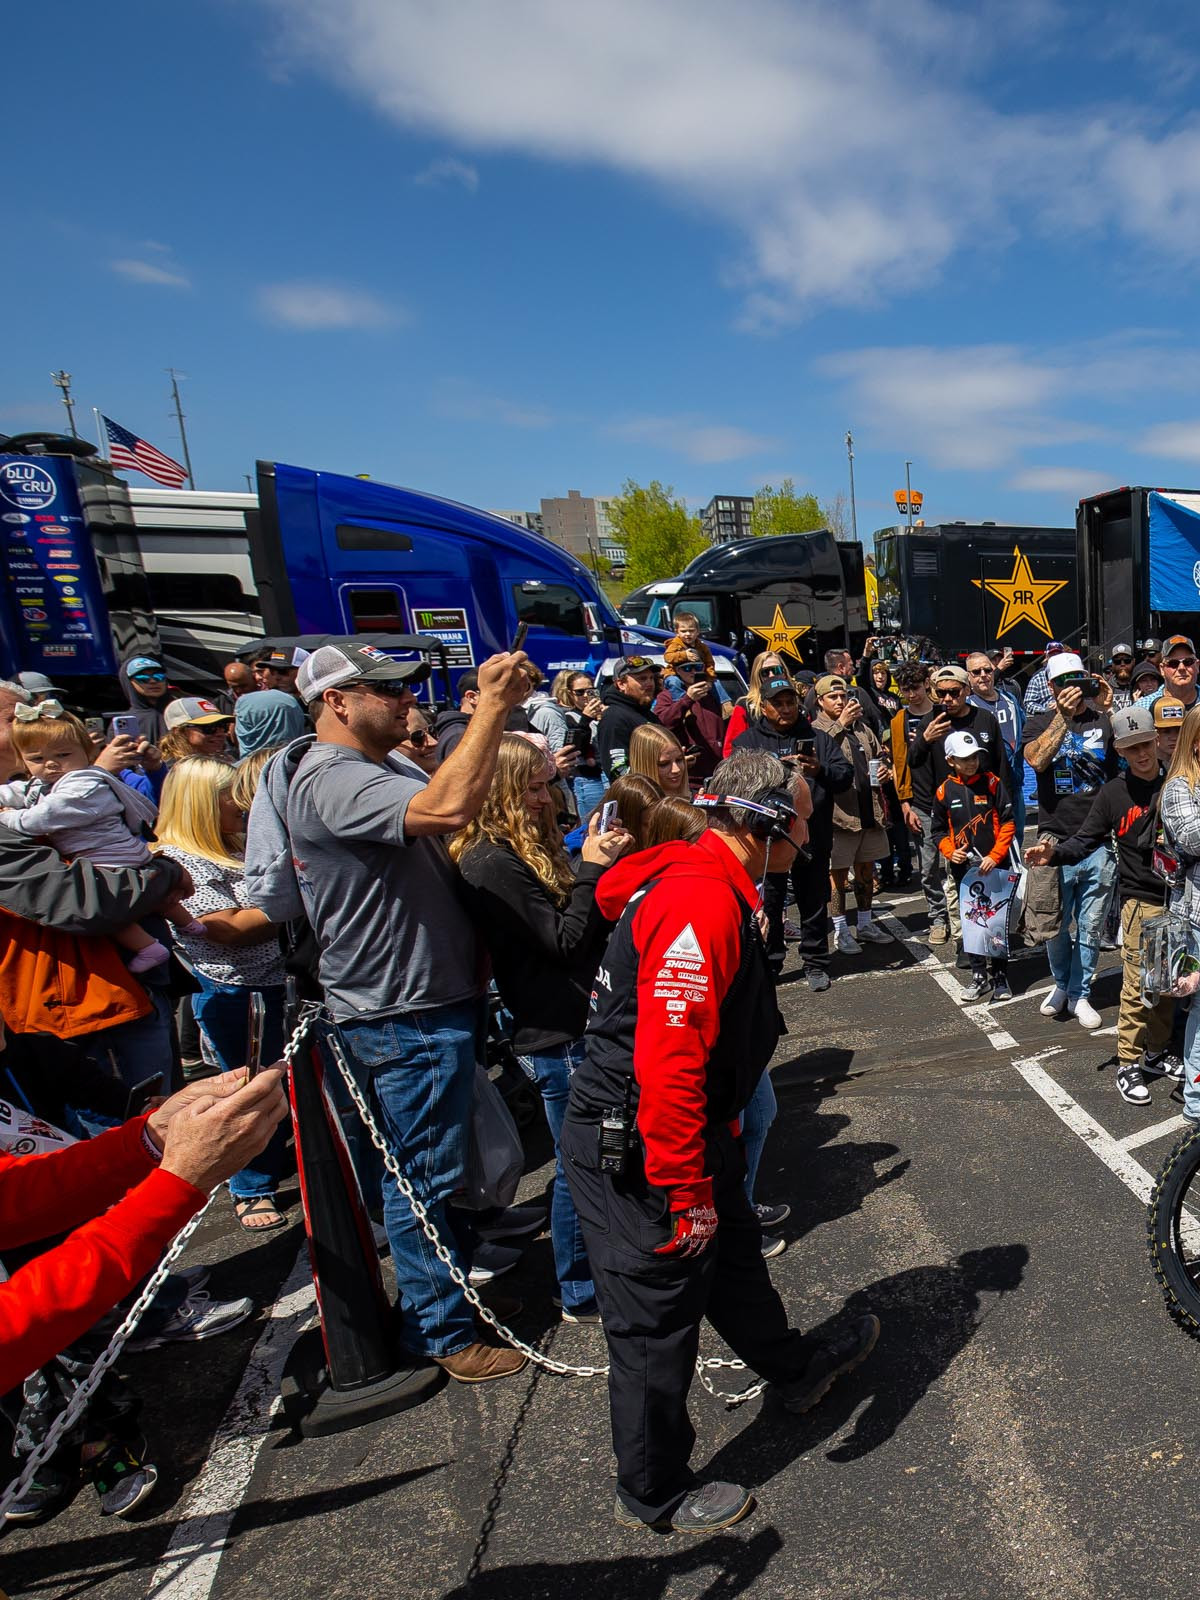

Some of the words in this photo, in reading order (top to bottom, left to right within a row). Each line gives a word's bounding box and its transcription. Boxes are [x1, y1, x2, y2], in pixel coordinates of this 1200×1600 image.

[6, 467, 35, 480] bLU
[22, 480, 51, 493] cRU
[898, 503, 907, 512] 10
[912, 504, 921, 512] 10
[664, 960, 702, 971] SHOWA
